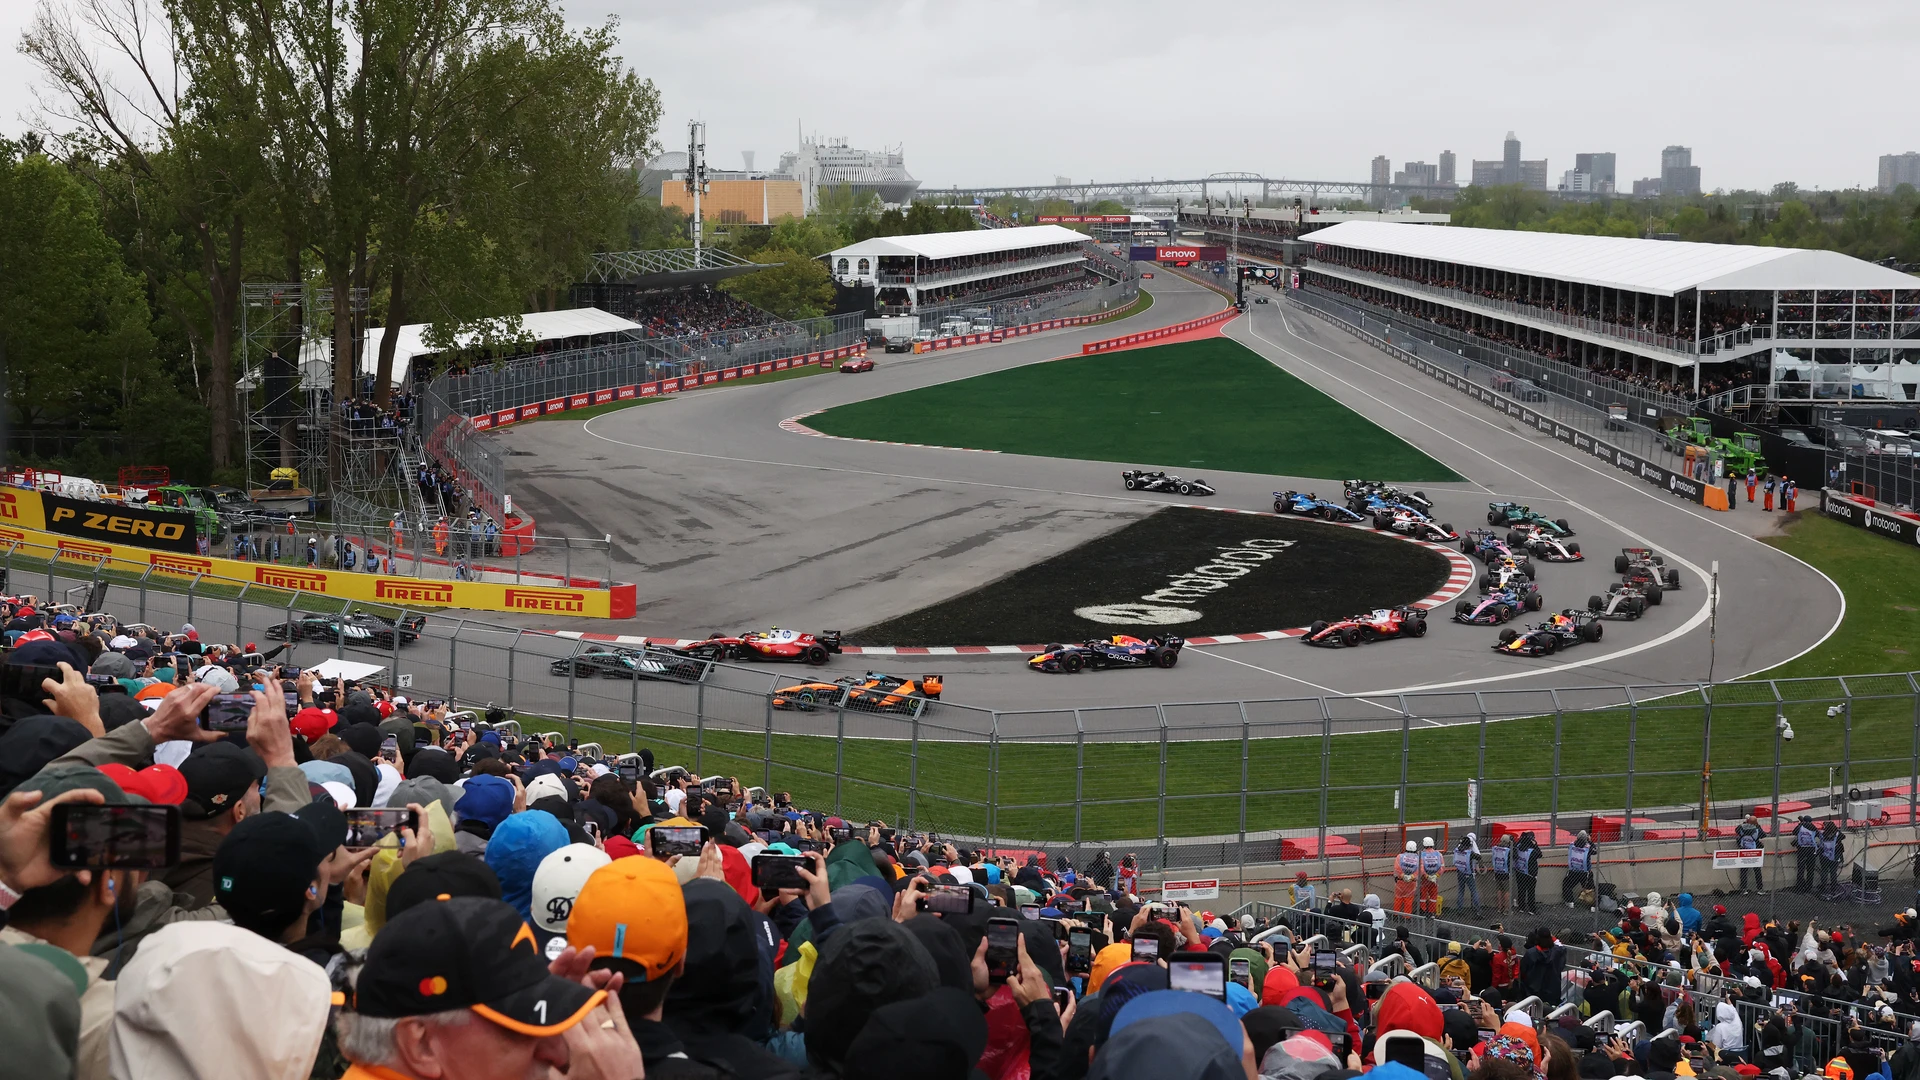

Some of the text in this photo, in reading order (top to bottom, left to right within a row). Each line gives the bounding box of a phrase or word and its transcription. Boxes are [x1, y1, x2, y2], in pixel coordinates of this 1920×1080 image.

[1159, 249, 1196, 258] Lenovo
[641, 386, 657, 394] Lenovo
[663, 382, 678, 390] Lenovo
[597, 393, 612, 401] Lenovo
[619, 389, 634, 397] Lenovo
[548, 402, 564, 411] Lenovo
[572, 397, 588, 406] Lenovo
[498, 412, 514, 422] Lenovo
[522, 407, 538, 417] Lenovo
[474, 418, 491, 428] Lenovo
[1599, 445, 1611, 458] motorola
[1621, 456, 1635, 469] motorola
[1645, 467, 1662, 481] motorola
[1675, 480, 1696, 495] motorola
[52, 507, 186, 541] P ZERO
[1872, 515, 1901, 534] motorola
[1140, 538, 1298, 604] motorola
[255, 567, 328, 592] PIRELLI
[375, 579, 454, 603] PIRELLI
[504, 588, 584, 612] PIRELLI
[1107, 652, 1136, 662] ORACLE
[533, 999, 547, 1024] 1
